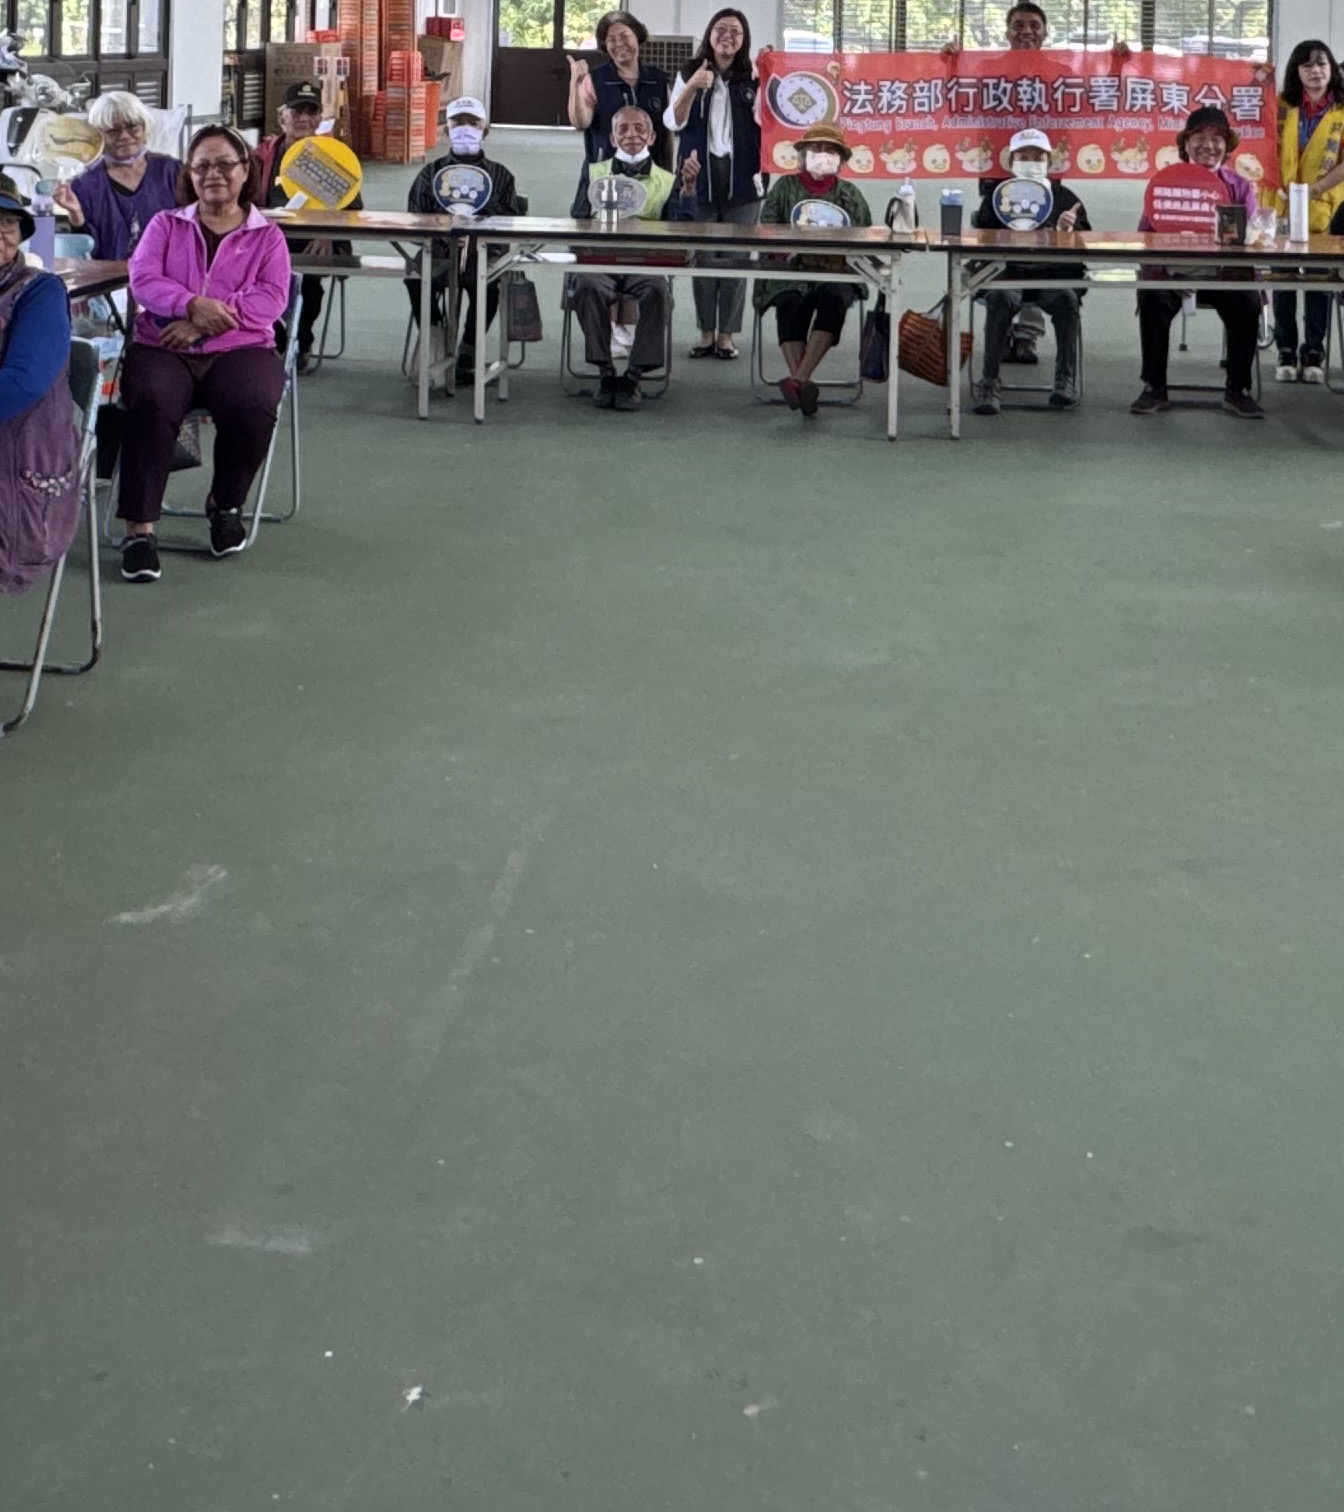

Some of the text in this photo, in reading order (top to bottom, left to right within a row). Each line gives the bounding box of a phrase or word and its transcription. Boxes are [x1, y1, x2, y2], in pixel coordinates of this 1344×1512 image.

[842, 76, 1264, 122] 法務部行政執行署屏東分署
